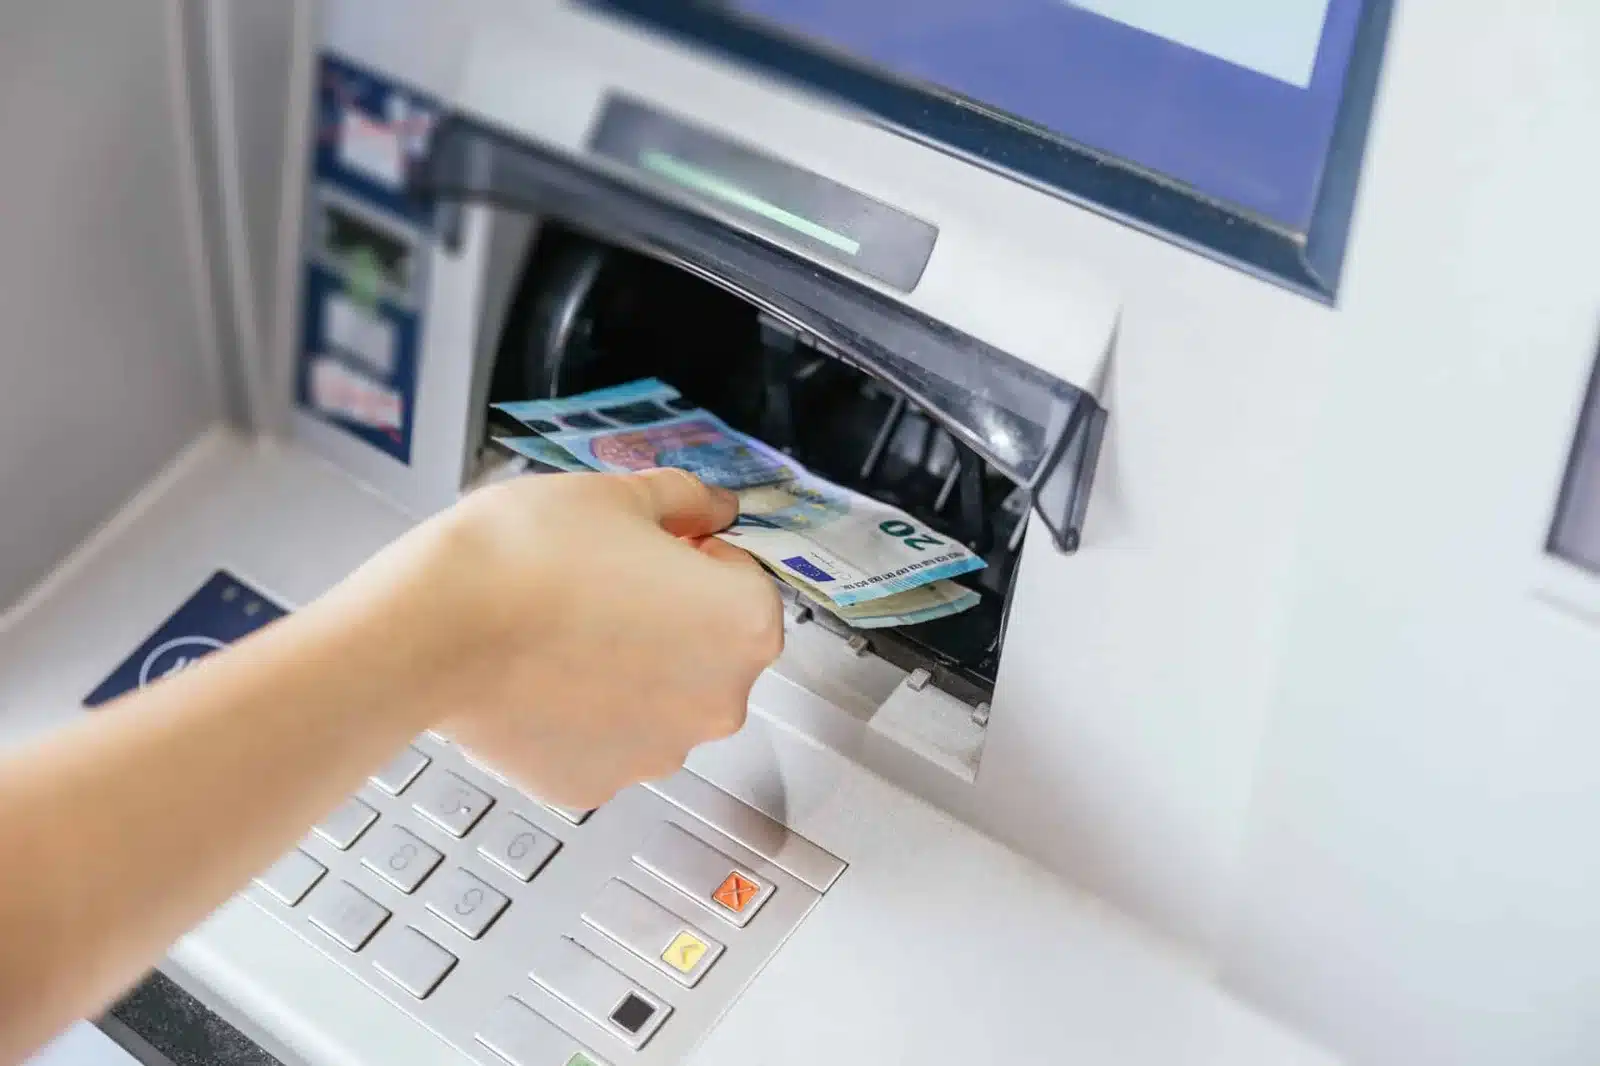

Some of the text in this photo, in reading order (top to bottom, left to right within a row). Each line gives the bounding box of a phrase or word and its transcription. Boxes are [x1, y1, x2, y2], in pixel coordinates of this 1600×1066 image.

[878, 519, 945, 551] 20
[507, 832, 536, 860] 6
[455, 888, 484, 915] 9
